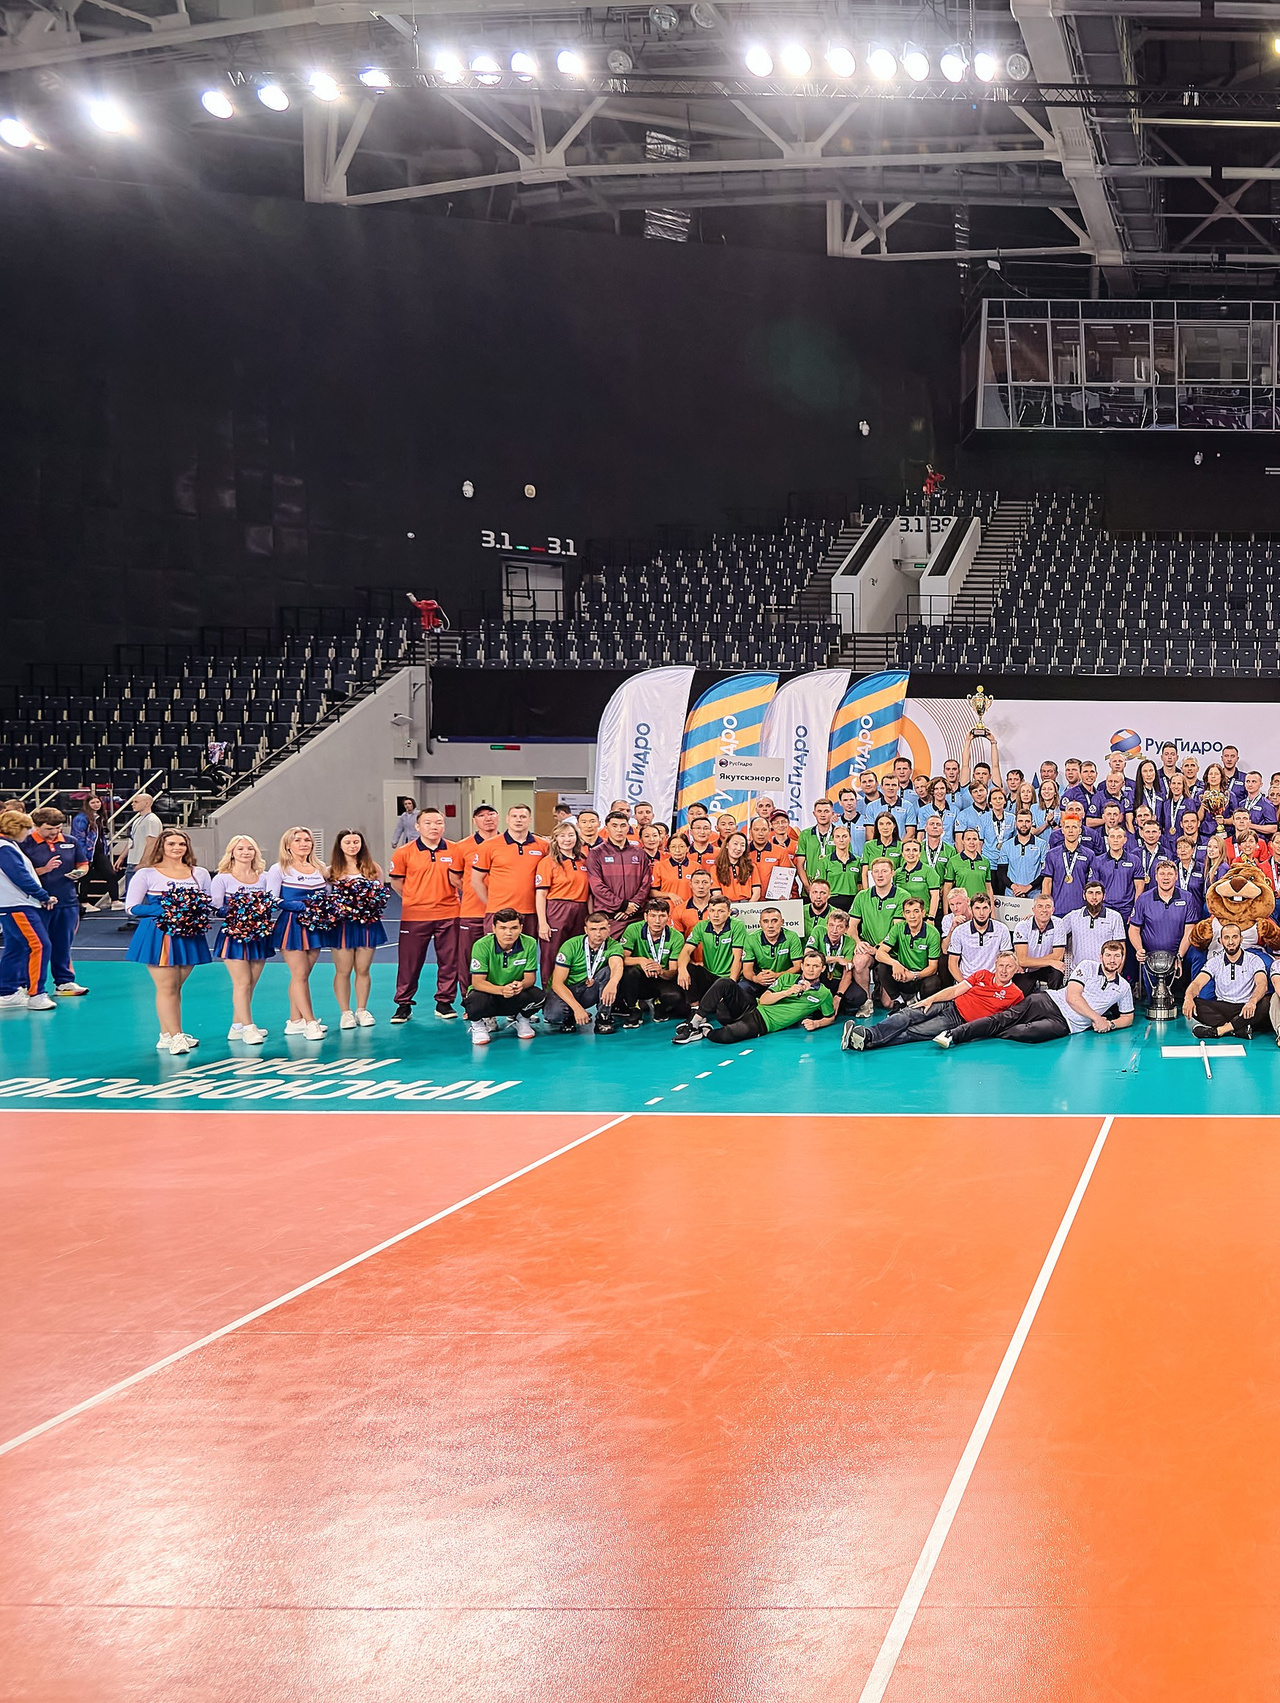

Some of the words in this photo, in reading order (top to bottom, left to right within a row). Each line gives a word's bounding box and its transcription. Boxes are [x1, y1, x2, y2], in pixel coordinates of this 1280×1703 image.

[900, 518, 924, 533] 3.1
[481, 530, 513, 550] 3.1
[547, 537, 578, 556] 3.1
[849, 715, 874, 795] сГидро
[1145, 738, 1223, 755] РуГидро
[625, 722, 652, 807] усГидро
[710, 715, 740, 813] Рудро
[787, 725, 810, 822] РусГидро
[719, 773, 781, 784] Якутскэнерго
[1004, 914, 1019, 922] Сиб
[169, 1058, 401, 1077] КРАЙ
